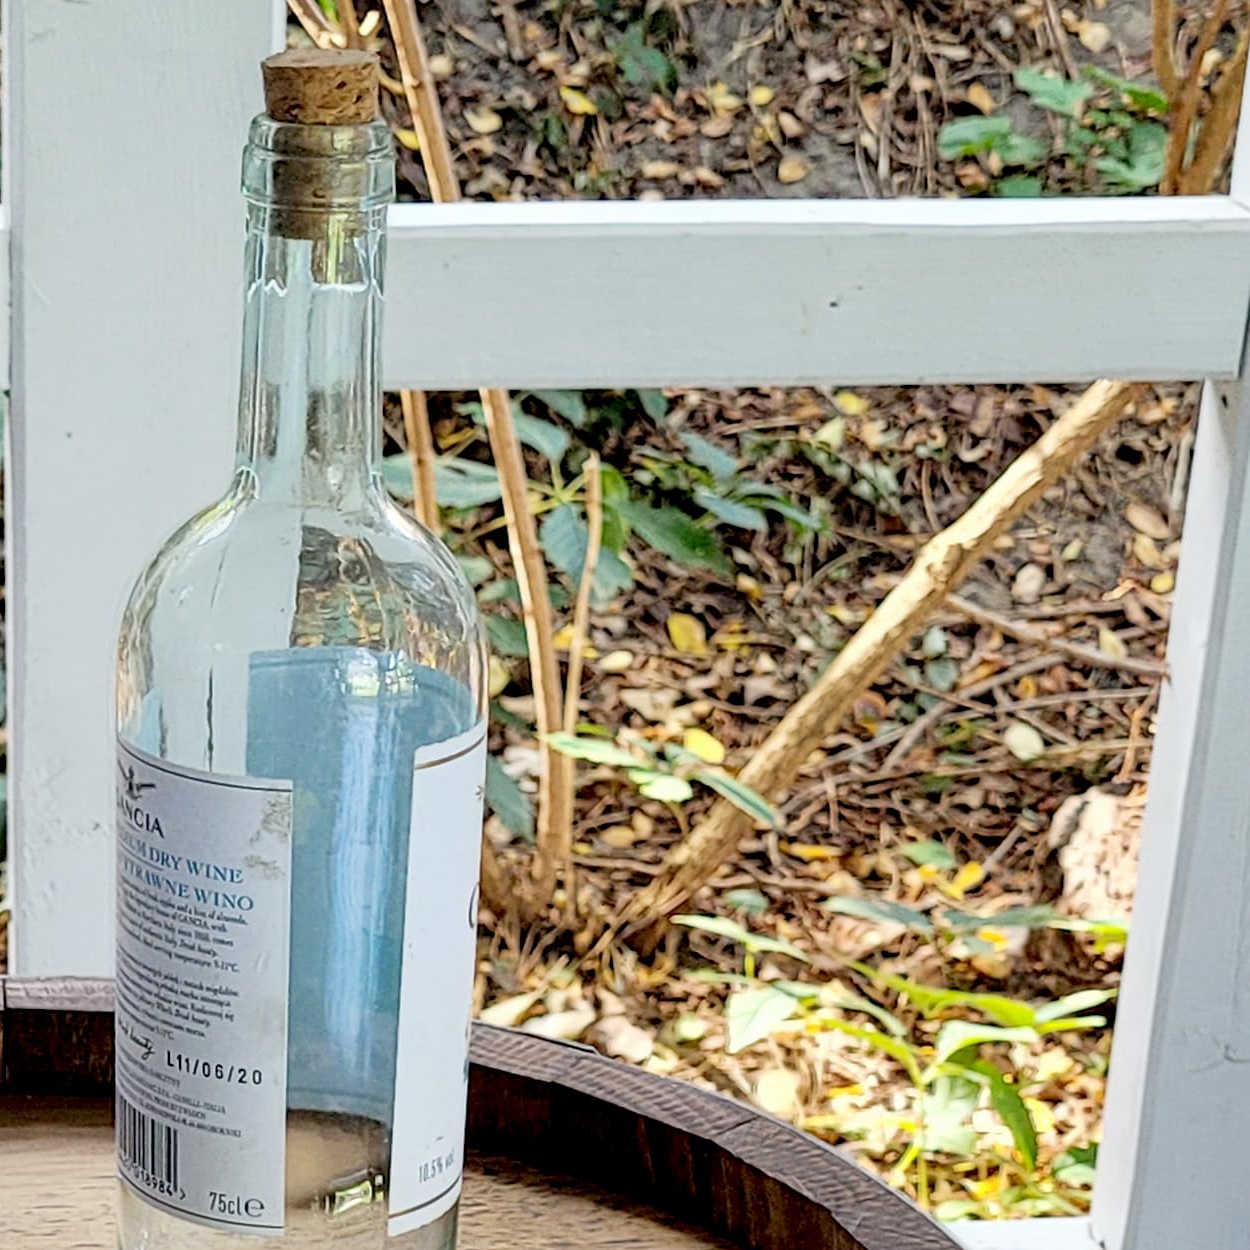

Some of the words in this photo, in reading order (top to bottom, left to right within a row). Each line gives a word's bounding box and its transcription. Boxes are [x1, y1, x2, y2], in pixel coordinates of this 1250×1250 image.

[150, 846, 182, 871] DRY
[187, 858, 244, 883] WINE
[194, 887, 254, 911] WINO
[167, 1050, 263, 1085] L11/06/20
